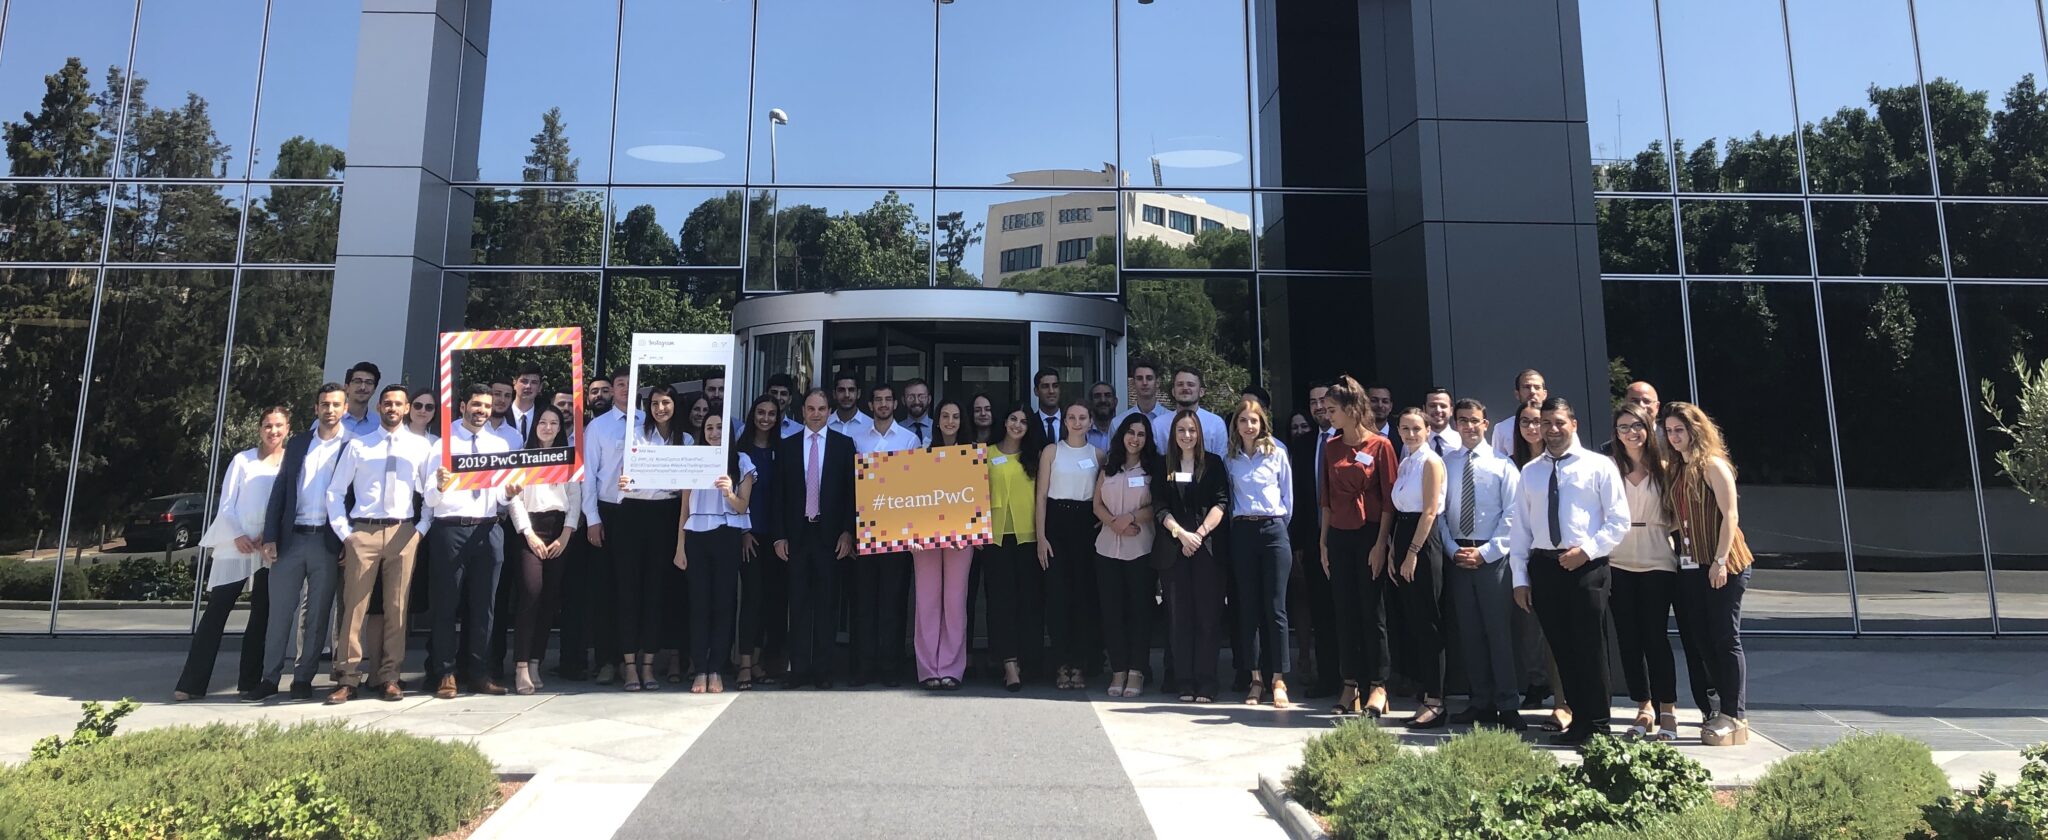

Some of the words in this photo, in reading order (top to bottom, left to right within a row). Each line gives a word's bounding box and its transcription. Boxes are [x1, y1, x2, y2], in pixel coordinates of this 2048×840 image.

[458, 455, 488, 469] 2019
[490, 453, 518, 467] PwC
[519, 450, 568, 464] Trainee!
[872, 486, 975, 511] #teamPwC
